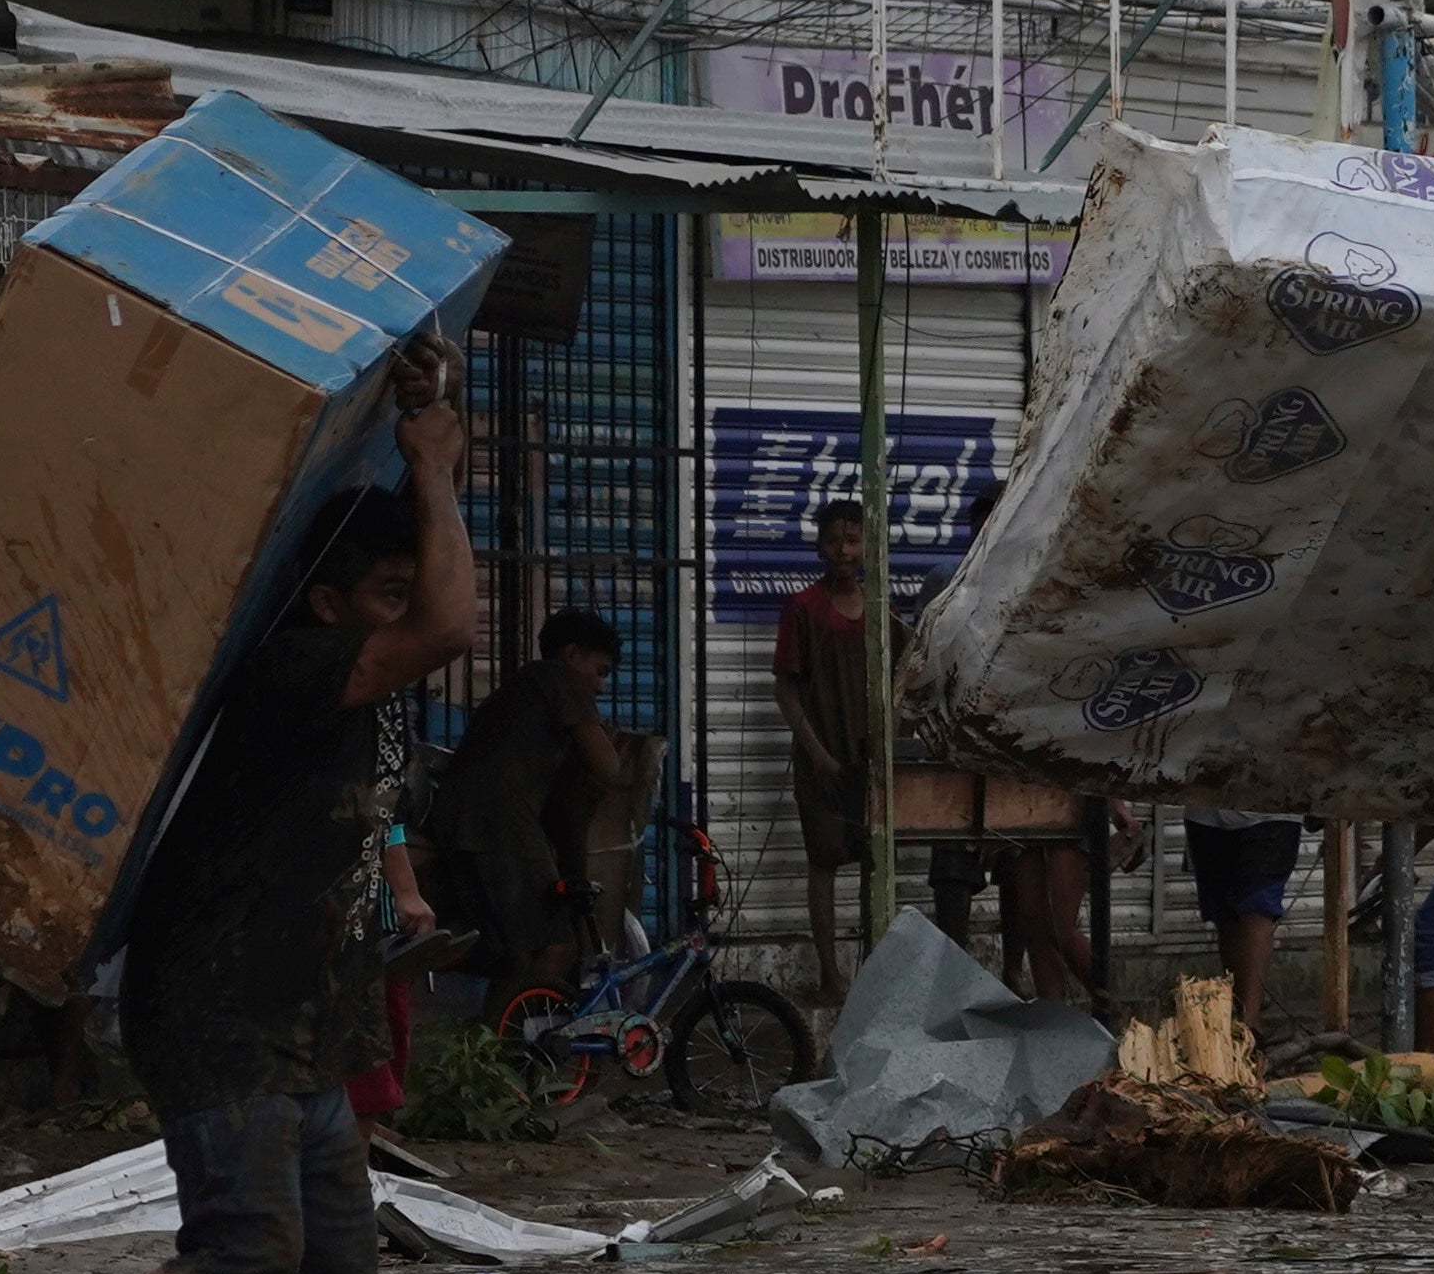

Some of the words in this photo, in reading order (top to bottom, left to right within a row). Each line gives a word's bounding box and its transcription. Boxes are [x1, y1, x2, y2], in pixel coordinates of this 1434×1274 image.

[890, 248, 949, 269] BELLEZA
[952, 251, 960, 269] Y
[965, 249, 1050, 272] COSMETICOS
[1281, 277, 1404, 325] SPRING
[1158, 570, 1216, 603] AIR
